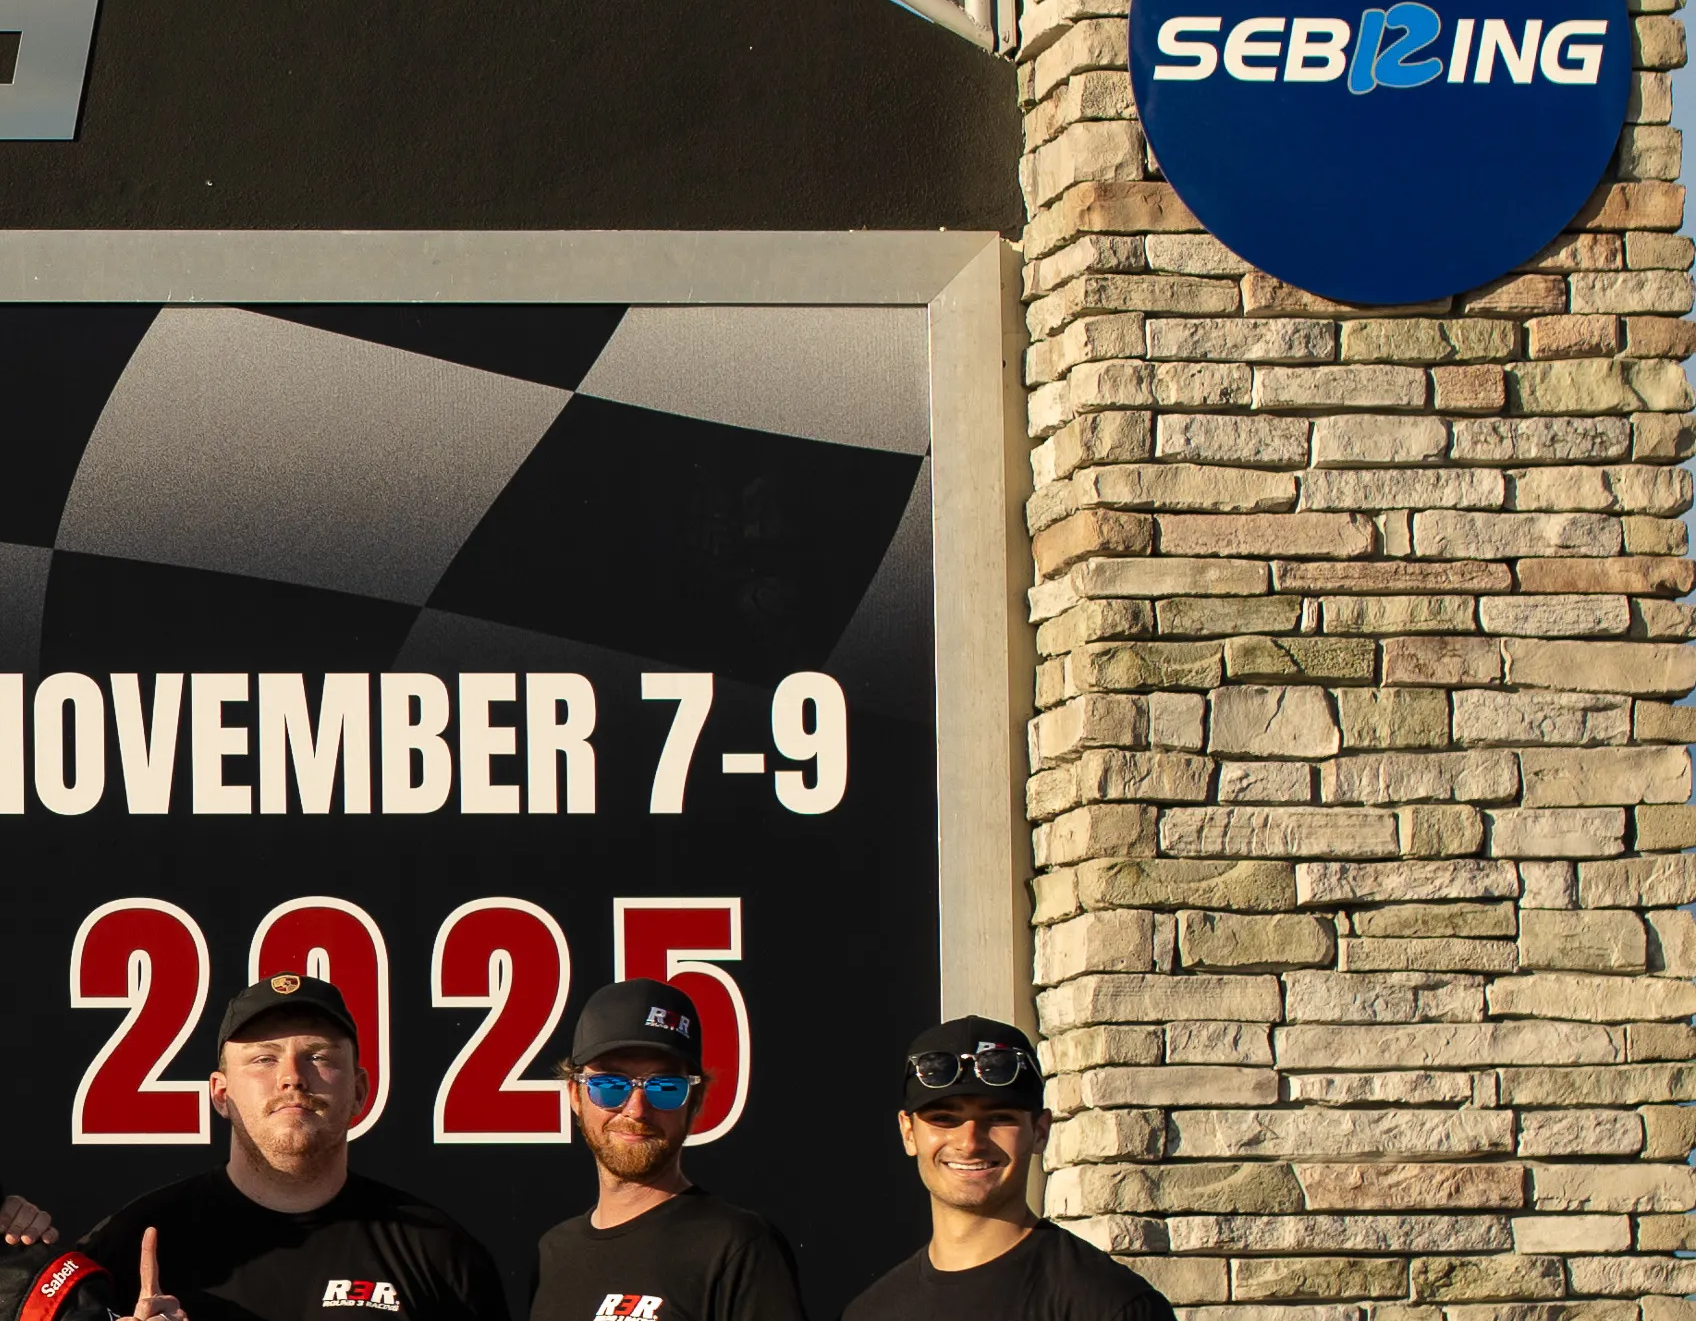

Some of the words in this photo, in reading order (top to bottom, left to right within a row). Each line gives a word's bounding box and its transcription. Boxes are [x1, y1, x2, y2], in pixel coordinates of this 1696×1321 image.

[641, 670, 850, 815] 7-9
[69, 895, 751, 1145] 2025
[41, 1258, 79, 1298] Sabelt
